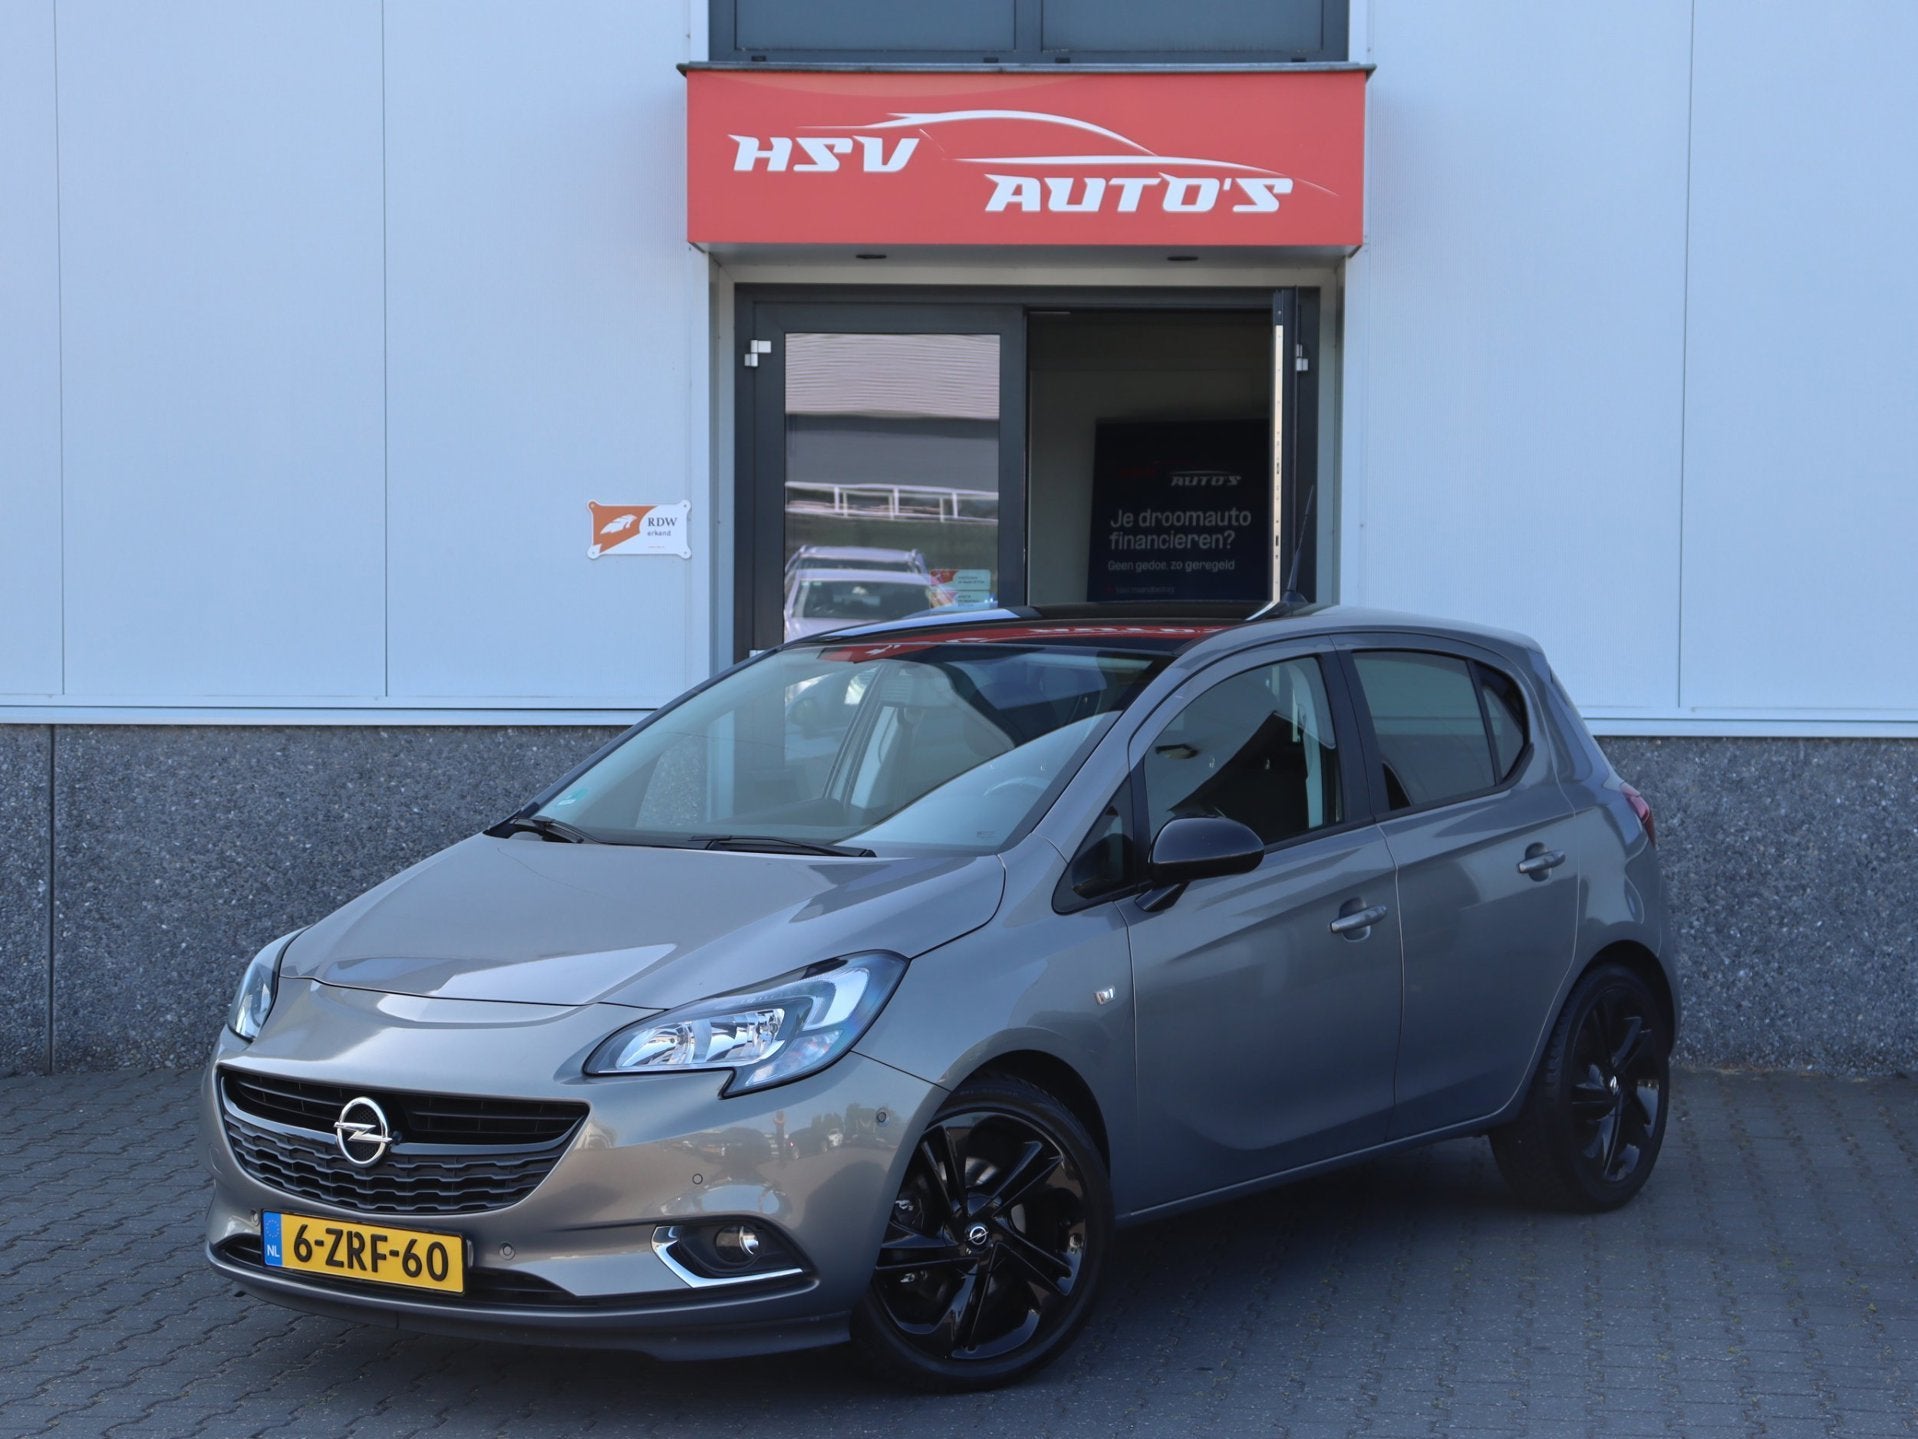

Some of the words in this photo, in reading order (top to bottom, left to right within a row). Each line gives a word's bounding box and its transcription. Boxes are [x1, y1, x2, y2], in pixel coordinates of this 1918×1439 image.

[728, 134, 920, 173] HSV
[984, 172, 1293, 213] AUTO'S
[1171, 475, 1243, 486] AUTO'S
[648, 517, 677, 527] RDW
[1110, 508, 1134, 528] Je
[1138, 507, 1252, 528] droomauto
[1109, 530, 1236, 550] financieren?
[1108, 560, 1133, 571] Geen
[1171, 561, 1183, 571] zo
[1185, 559, 1235, 573] geregeld
[266, 1244, 280, 1258] NL
[293, 1223, 449, 1282] 6-ZRF-60
